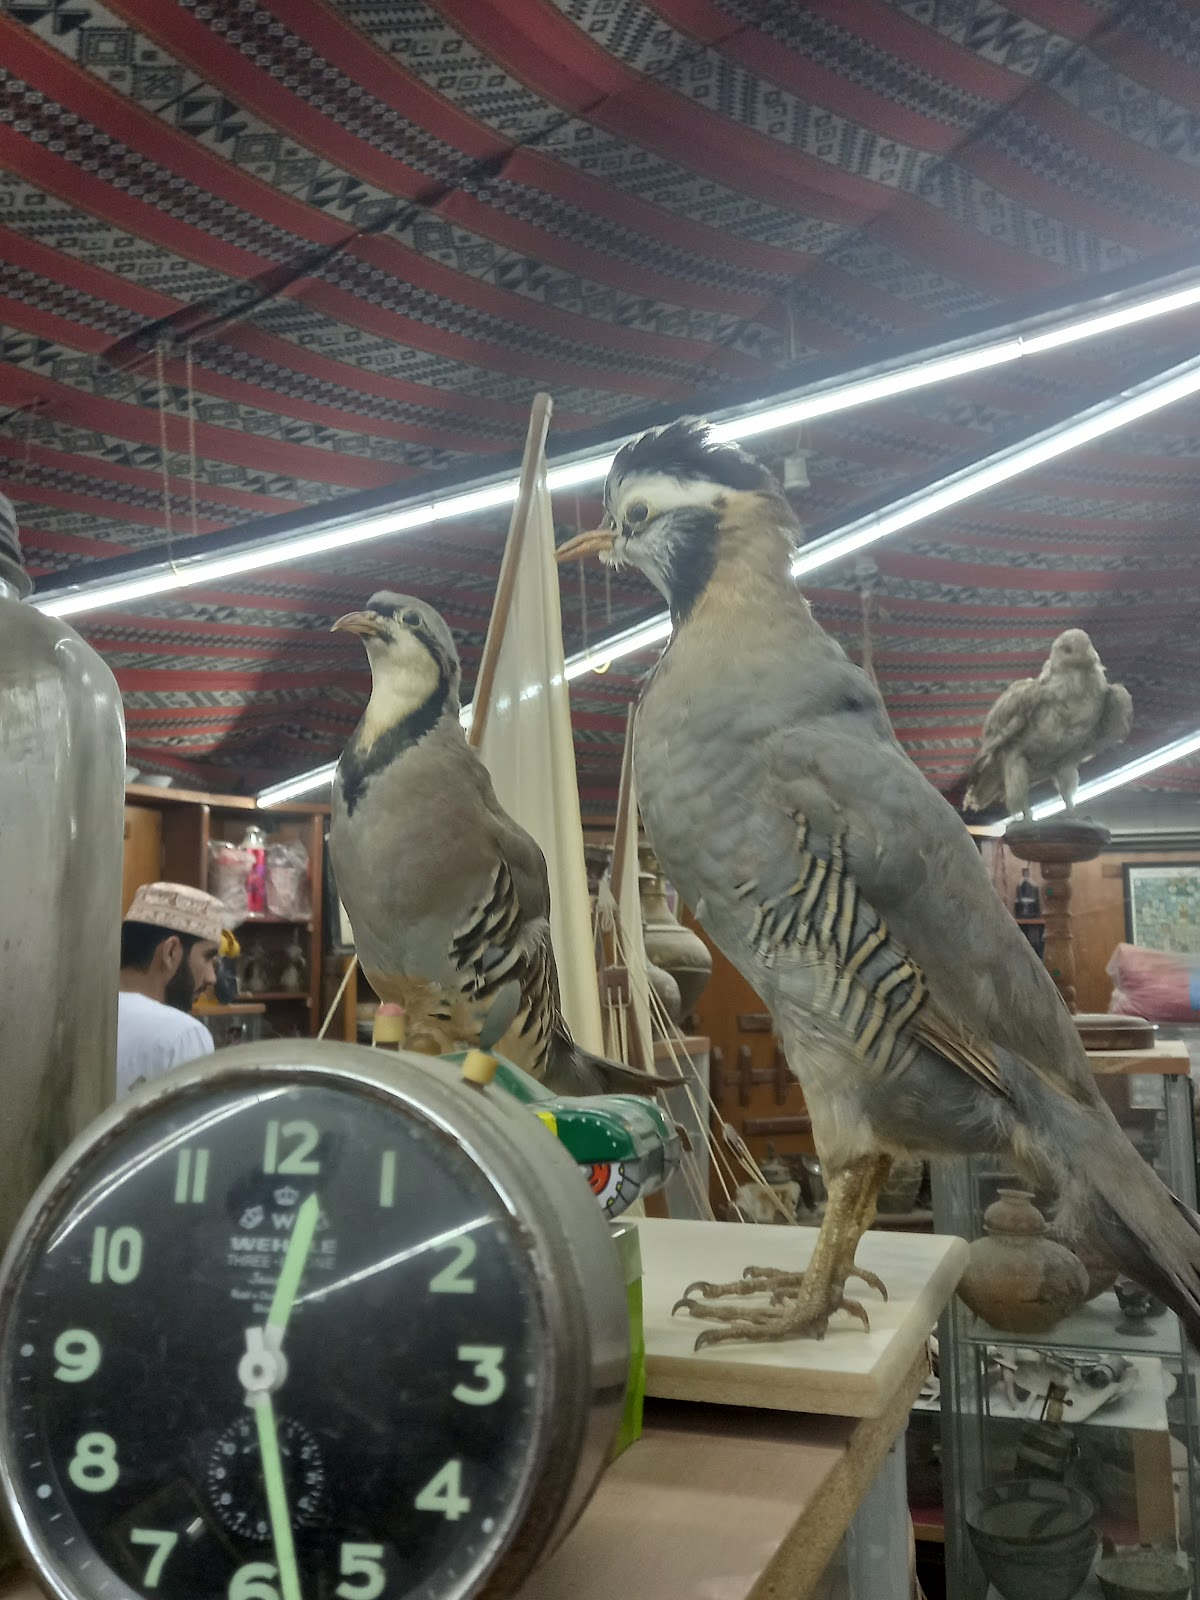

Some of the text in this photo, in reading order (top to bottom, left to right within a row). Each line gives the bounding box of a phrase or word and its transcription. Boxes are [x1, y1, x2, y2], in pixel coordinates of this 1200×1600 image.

[174, 1148, 210, 1204] 11
[263, 1119, 320, 1175] 12
[379, 1149, 396, 1208] 1
[89, 1226, 144, 1285] 10
[229, 1236, 337, 1254] WEHLE
[428, 1236, 477, 1294] 2
[53, 1328, 101, 1383] 9
[452, 1345, 506, 1406] 3
[68, 1432, 120, 1493] 8
[414, 1459, 472, 1521] 4
[130, 1528, 179, 1588] 7
[228, 1561, 280, 1600] 6
[335, 1542, 387, 1600] 5
